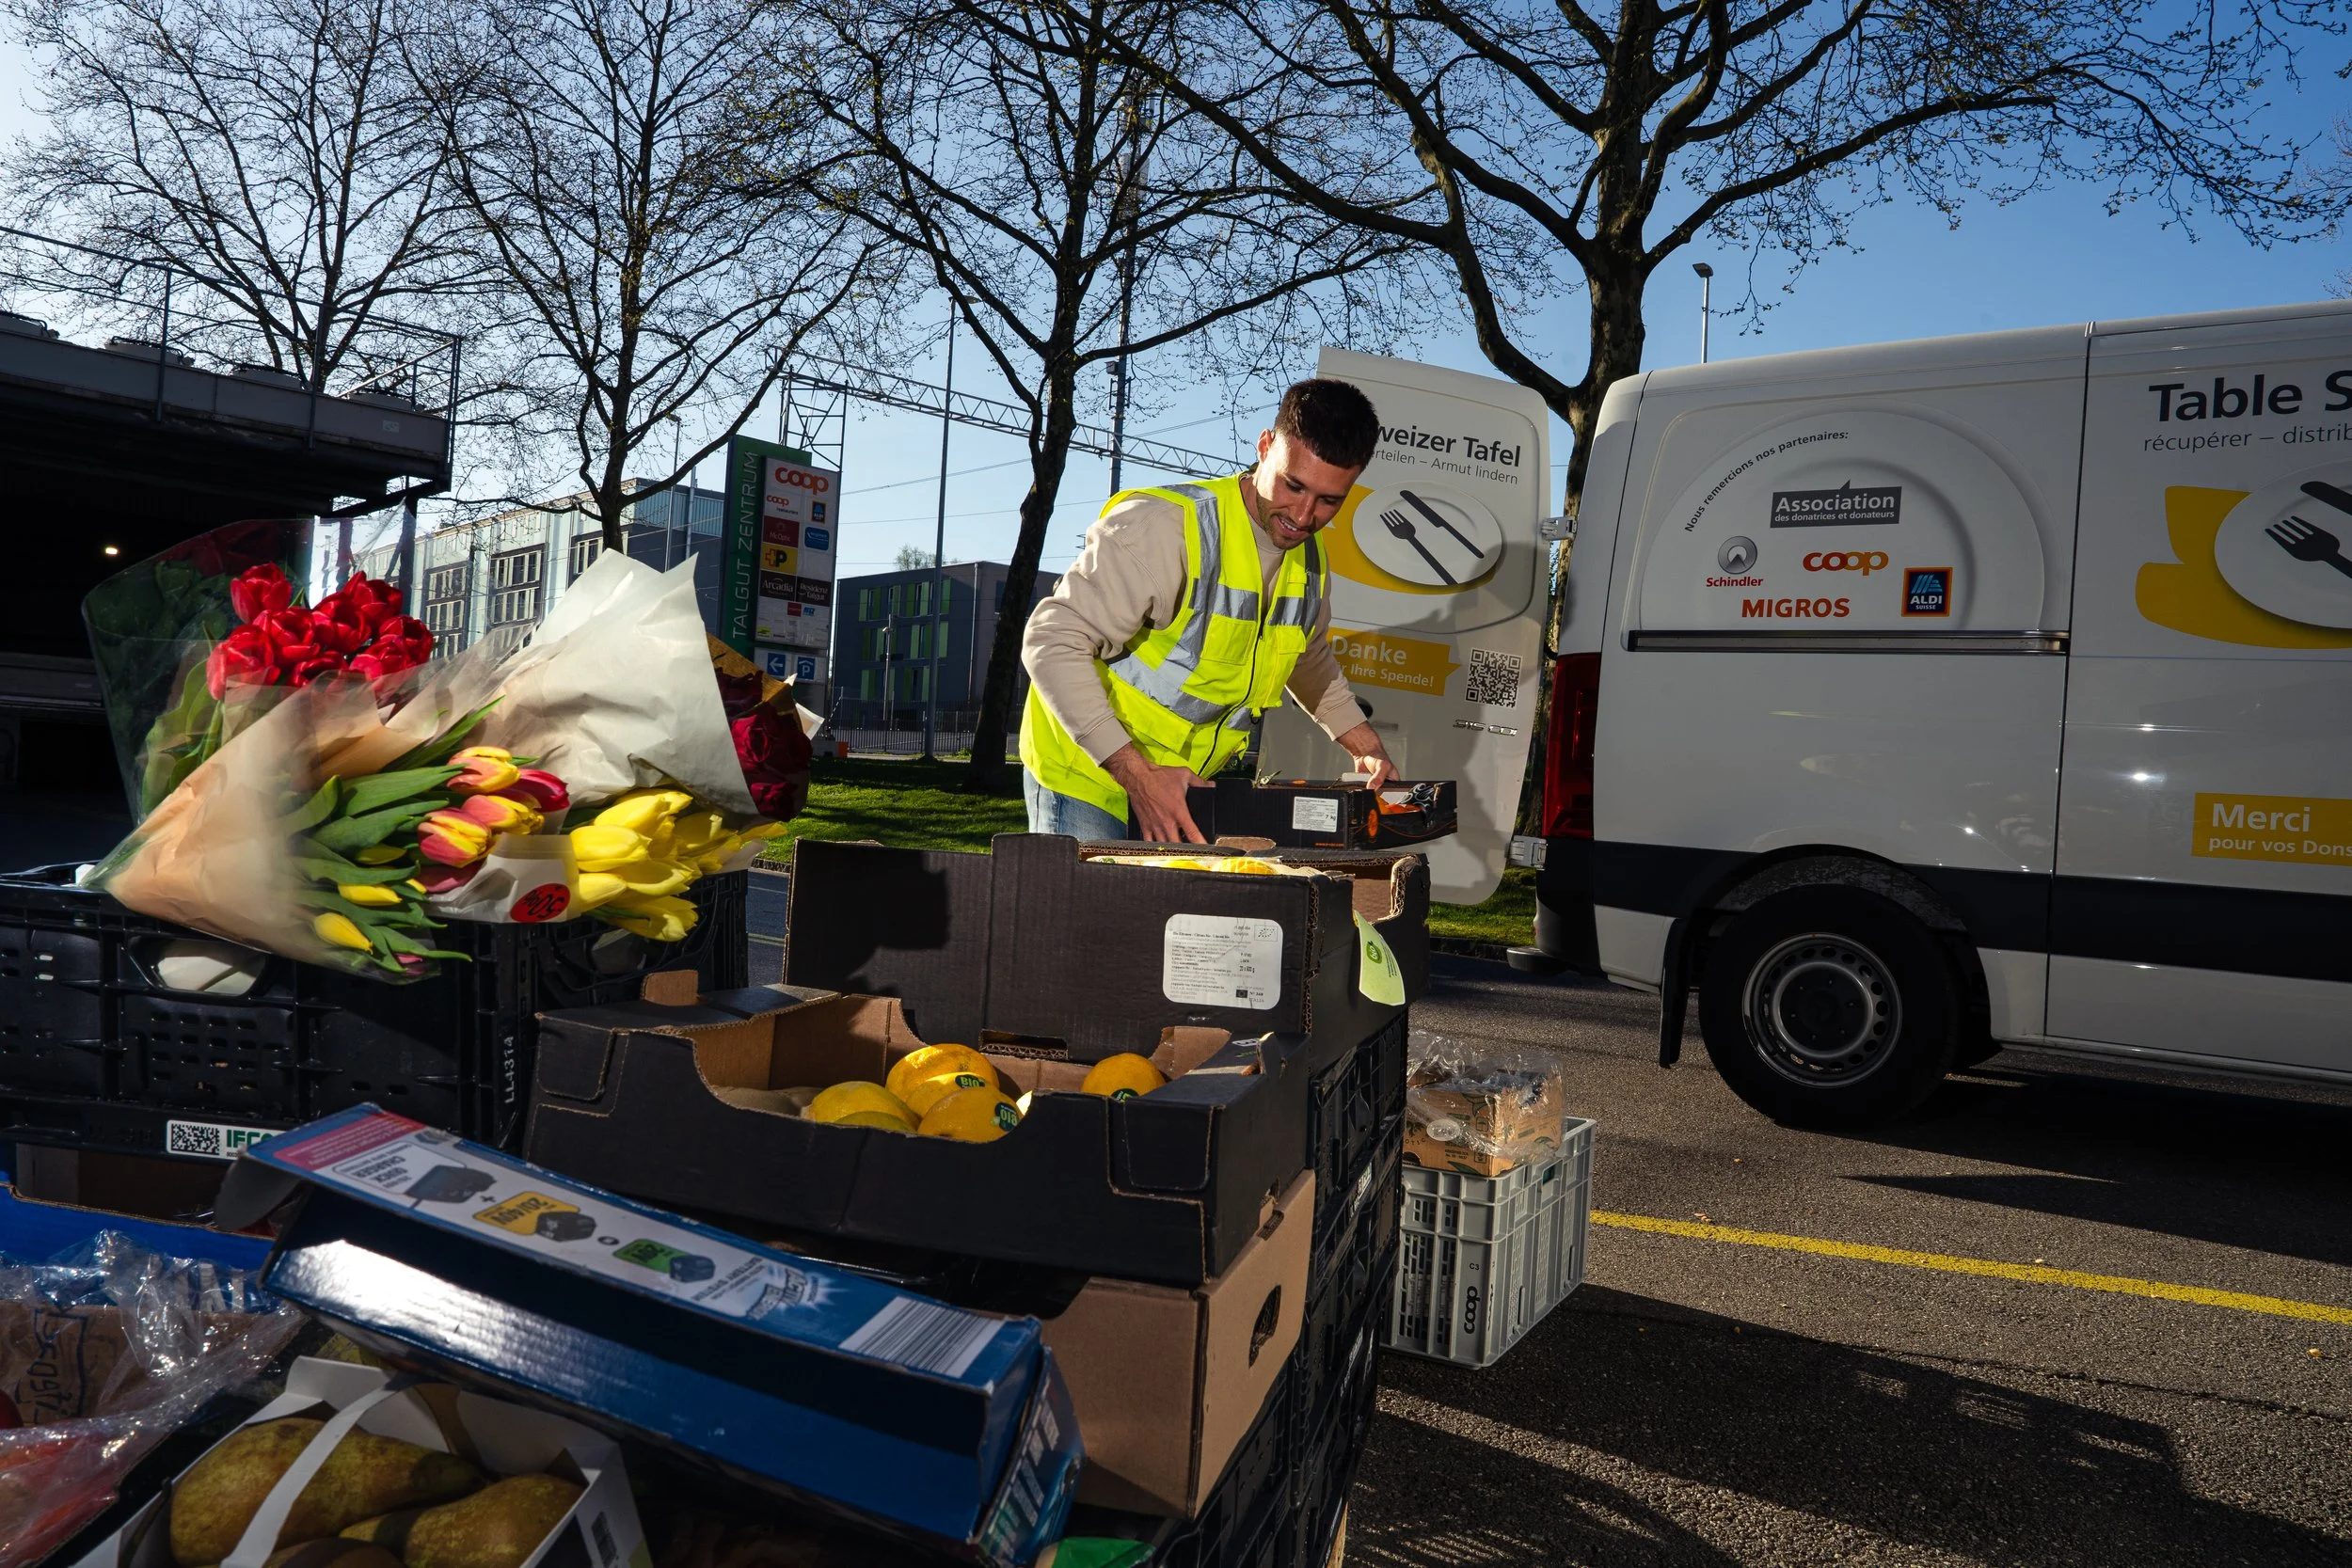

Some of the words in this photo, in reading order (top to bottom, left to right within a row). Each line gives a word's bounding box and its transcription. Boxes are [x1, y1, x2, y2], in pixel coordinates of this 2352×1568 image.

[2148, 373, 2303, 422] Table
[1377, 425, 1456, 453] weizer
[1463, 436, 1521, 467] Tafel
[2143, 431, 2253, 453] récupérer
[1374, 450, 1415, 465] rteilen
[1430, 457, 1472, 476] Armut
[1475, 465, 1518, 484] lindern
[774, 466, 829, 496] coop
[1684, 505, 1706, 532] Nous
[1703, 458, 1754, 506] remercions
[1755, 447, 1775, 462] nos
[1777, 431, 1849, 452] partenaires:
[738, 451, 758, 551] ZENTRUM
[766, 495, 789, 507] coop
[1774, 493, 1896, 513] Association
[1774, 514, 1789, 522] des
[1791, 512, 1836, 522] donatrices
[1850, 511, 1895, 519] donateurs
[1802, 550, 1889, 577] coop
[762, 578, 794, 593] Arcadia
[1706, 576, 1764, 588] Schindler
[732, 559, 750, 639] TALGUT
[1740, 597, 1851, 618] MIGROS
[1910, 594, 1943, 605] ALDI
[1331, 635, 1407, 665] Danke
[802, 664, 811, 677] P
[1350, 663, 1376, 678] Ihre
[1379, 668, 1434, 687] Spende!
[2212, 802, 2311, 832] Merci
[2209, 837, 2256, 852] pour
[2261, 840, 2296, 853] vos
[2302, 839, 2352, 857] Dons
[960, 1076, 980, 1087] BIO
[999, 1108, 1018, 1127] BIO
[227, 1129, 274, 1148] IFC
[1463, 1285, 1481, 1334] coop
